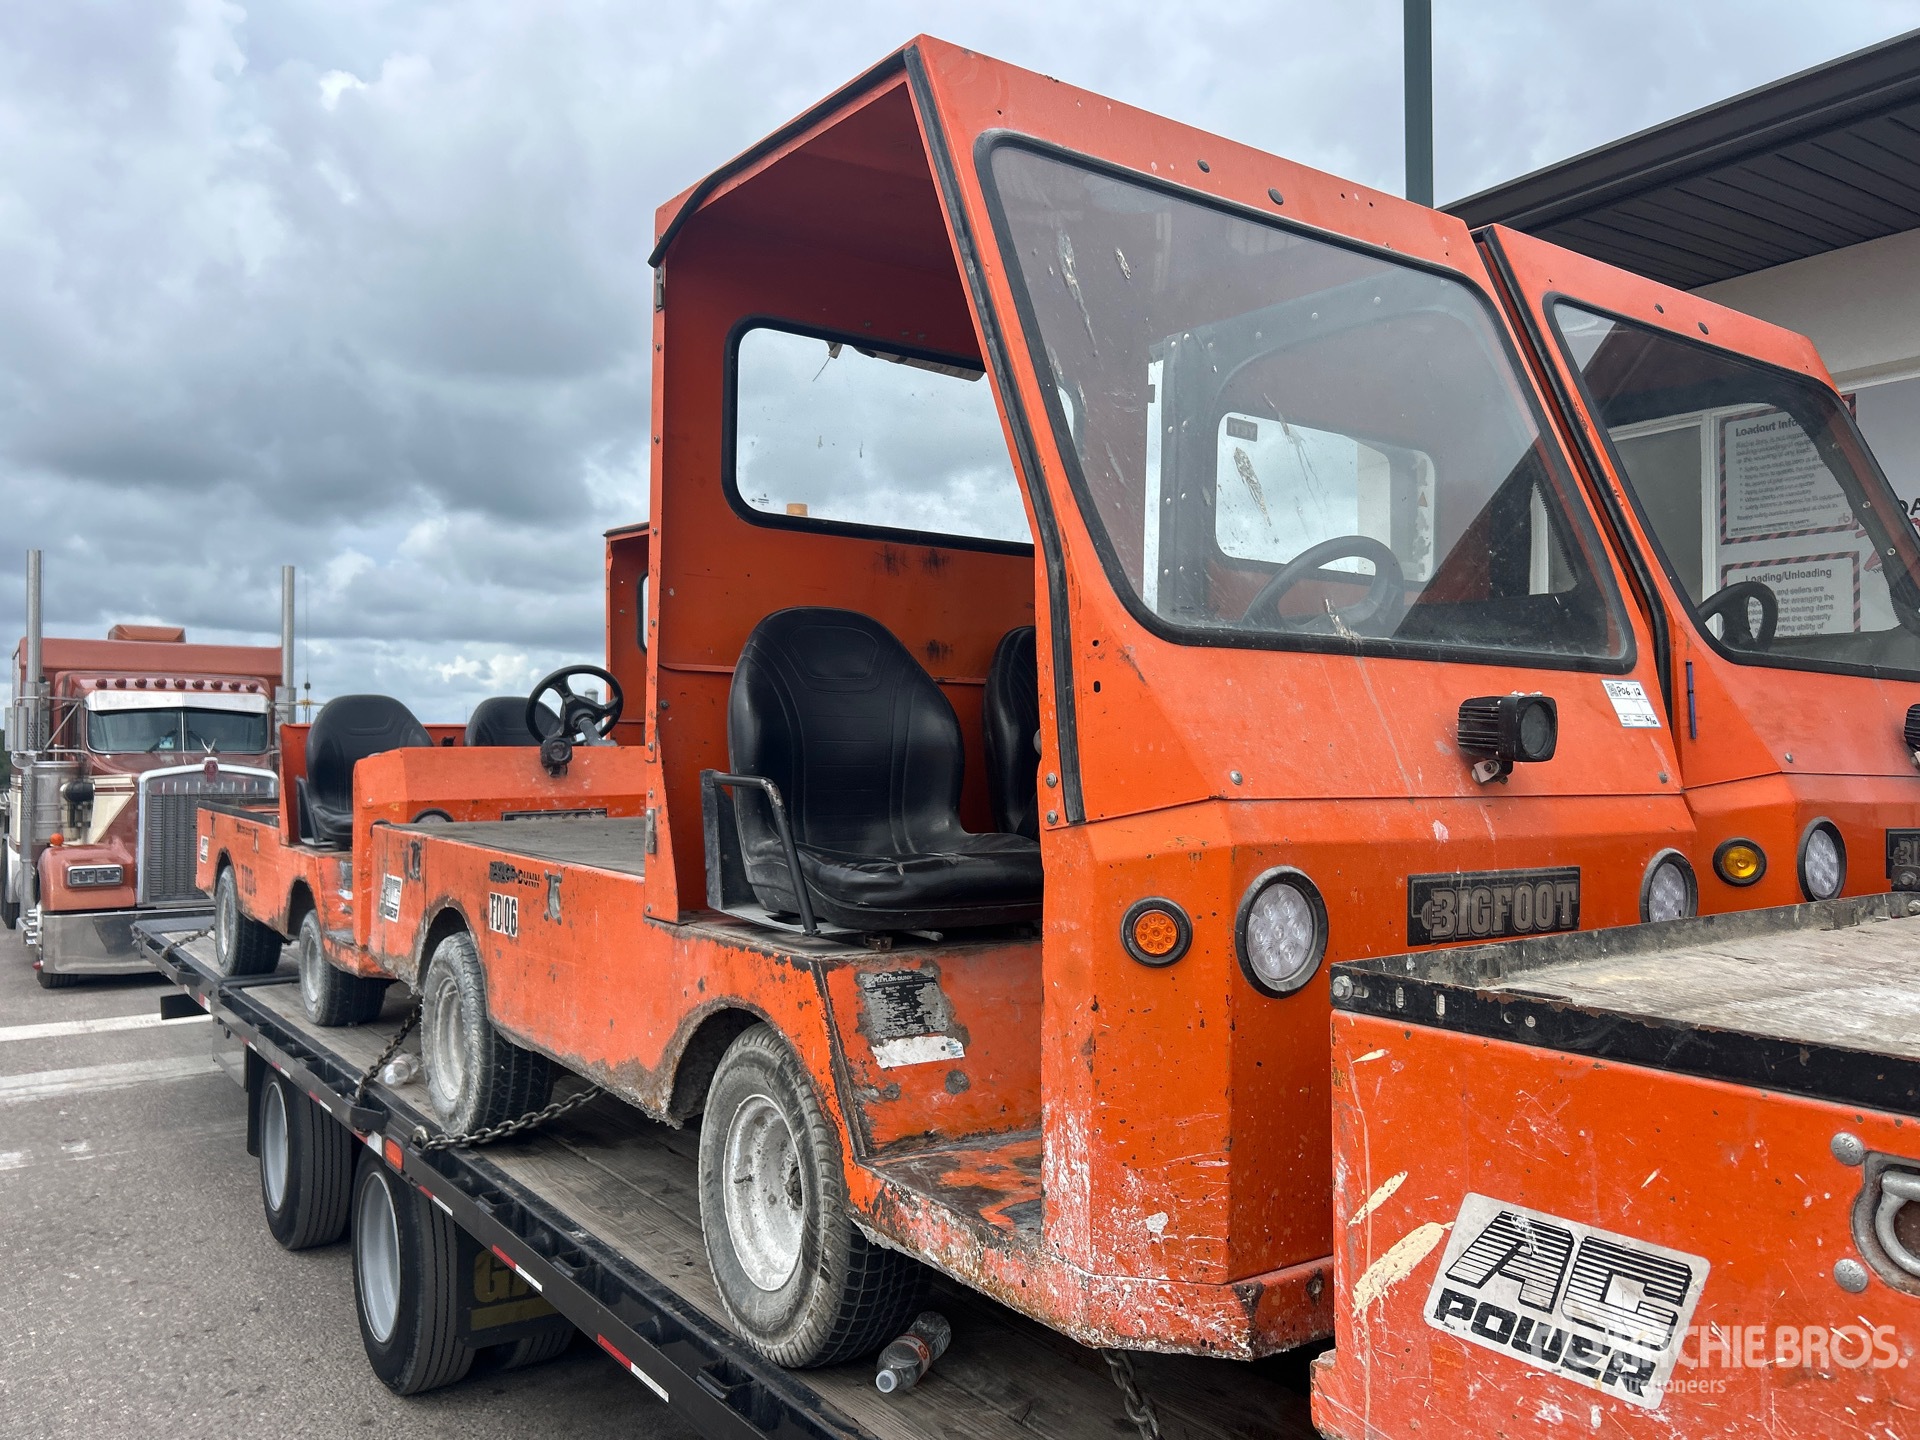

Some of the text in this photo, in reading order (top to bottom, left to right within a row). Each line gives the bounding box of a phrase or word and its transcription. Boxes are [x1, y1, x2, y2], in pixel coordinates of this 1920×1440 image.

[1736, 422, 1776, 437] Loadout
[1746, 568, 1832, 583] Loading/Unloading
[1430, 880, 1579, 940] BIGFOOT
[1445, 1210, 1693, 1352] AC
[1433, 1287, 1657, 1398] POWER
